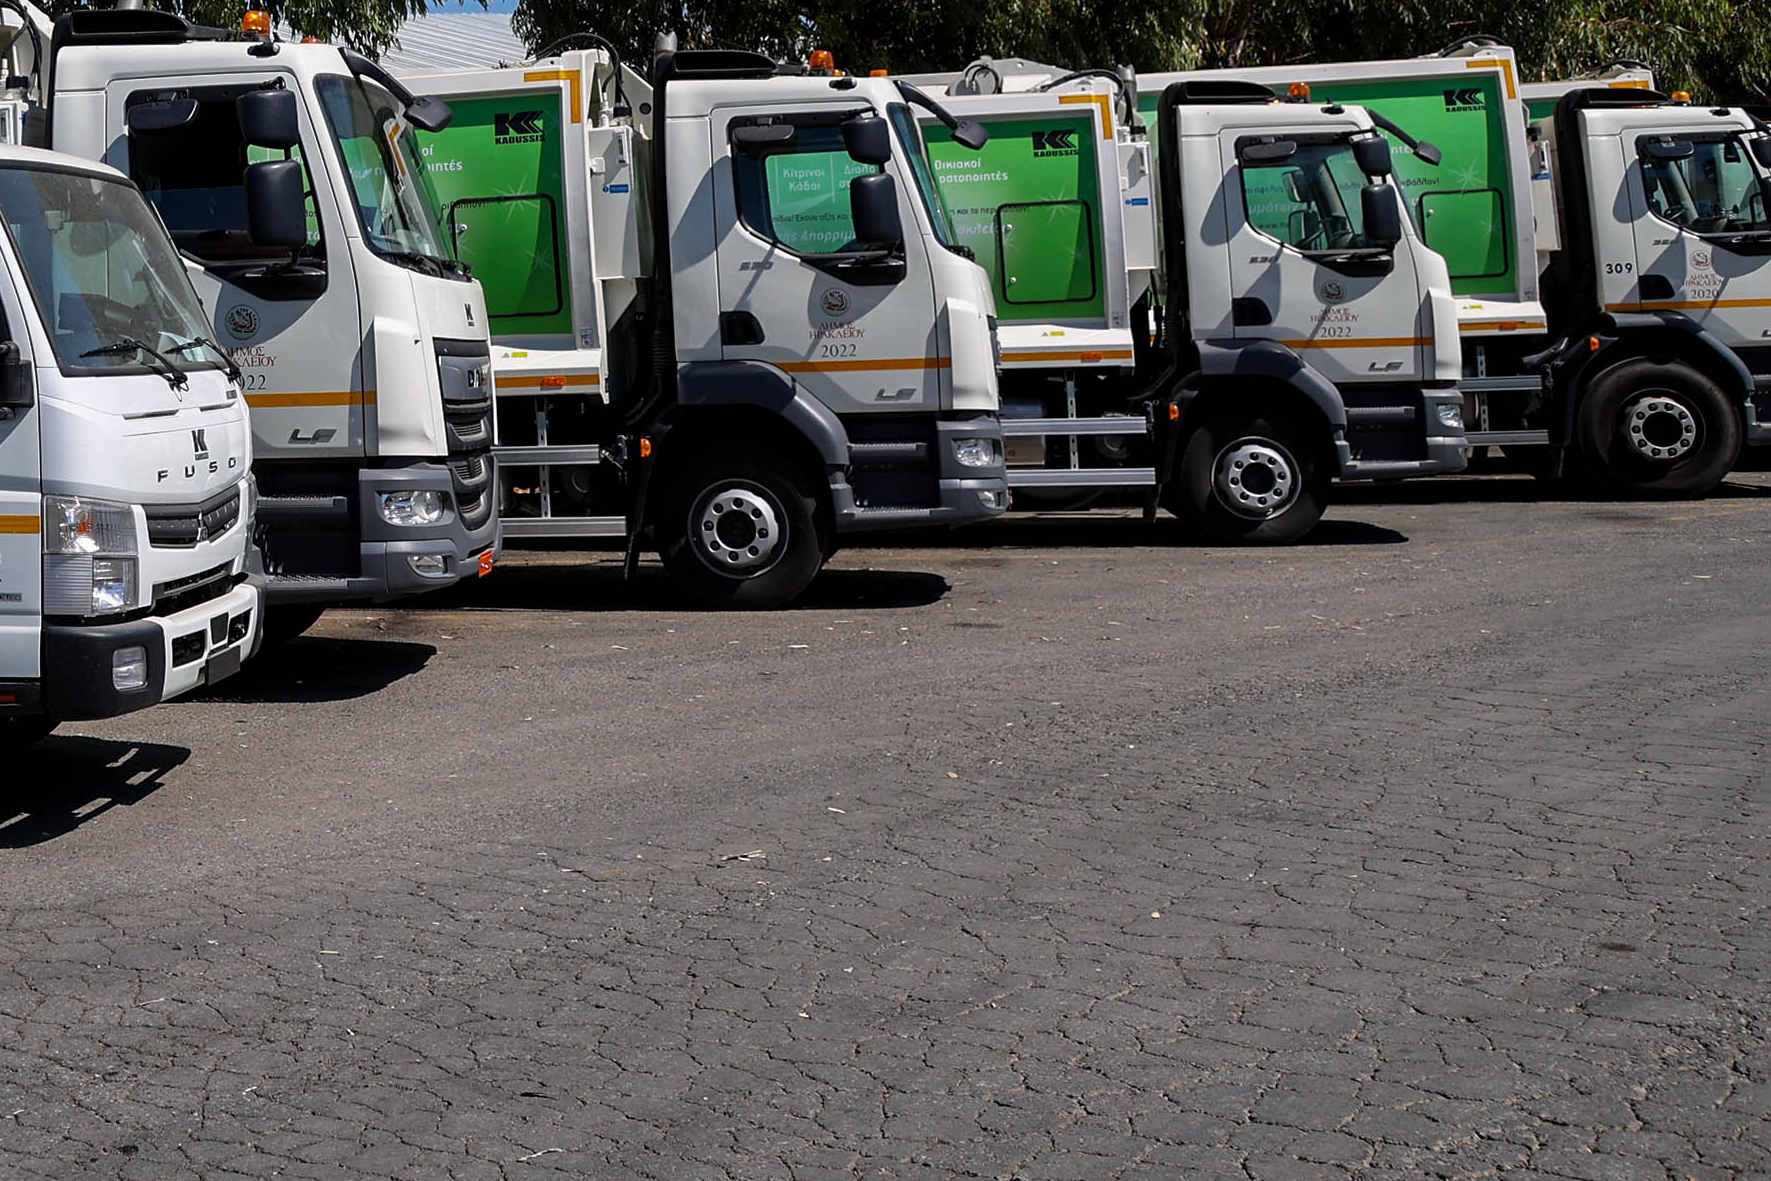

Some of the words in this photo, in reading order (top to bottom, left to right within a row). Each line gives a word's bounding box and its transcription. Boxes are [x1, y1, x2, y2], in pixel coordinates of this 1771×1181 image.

[494, 135, 546, 145] KAOUSSIS
[1033, 149, 1079, 158] KAOUSSIS
[844, 164, 876, 174] Διαλο
[934, 158, 981, 170] Οικιακοί
[939, 171, 1009, 184] οστοποιητές
[1605, 262, 1633, 275] 309
[1691, 289, 1719, 299] 2020
[1321, 326, 1352, 338] 2022
[821, 344, 857, 357] 2022
[233, 356, 277, 368] ΚΛΕΙΟΥ
[288, 428, 338, 445] LF
[157, 457, 237, 484] FUSO
